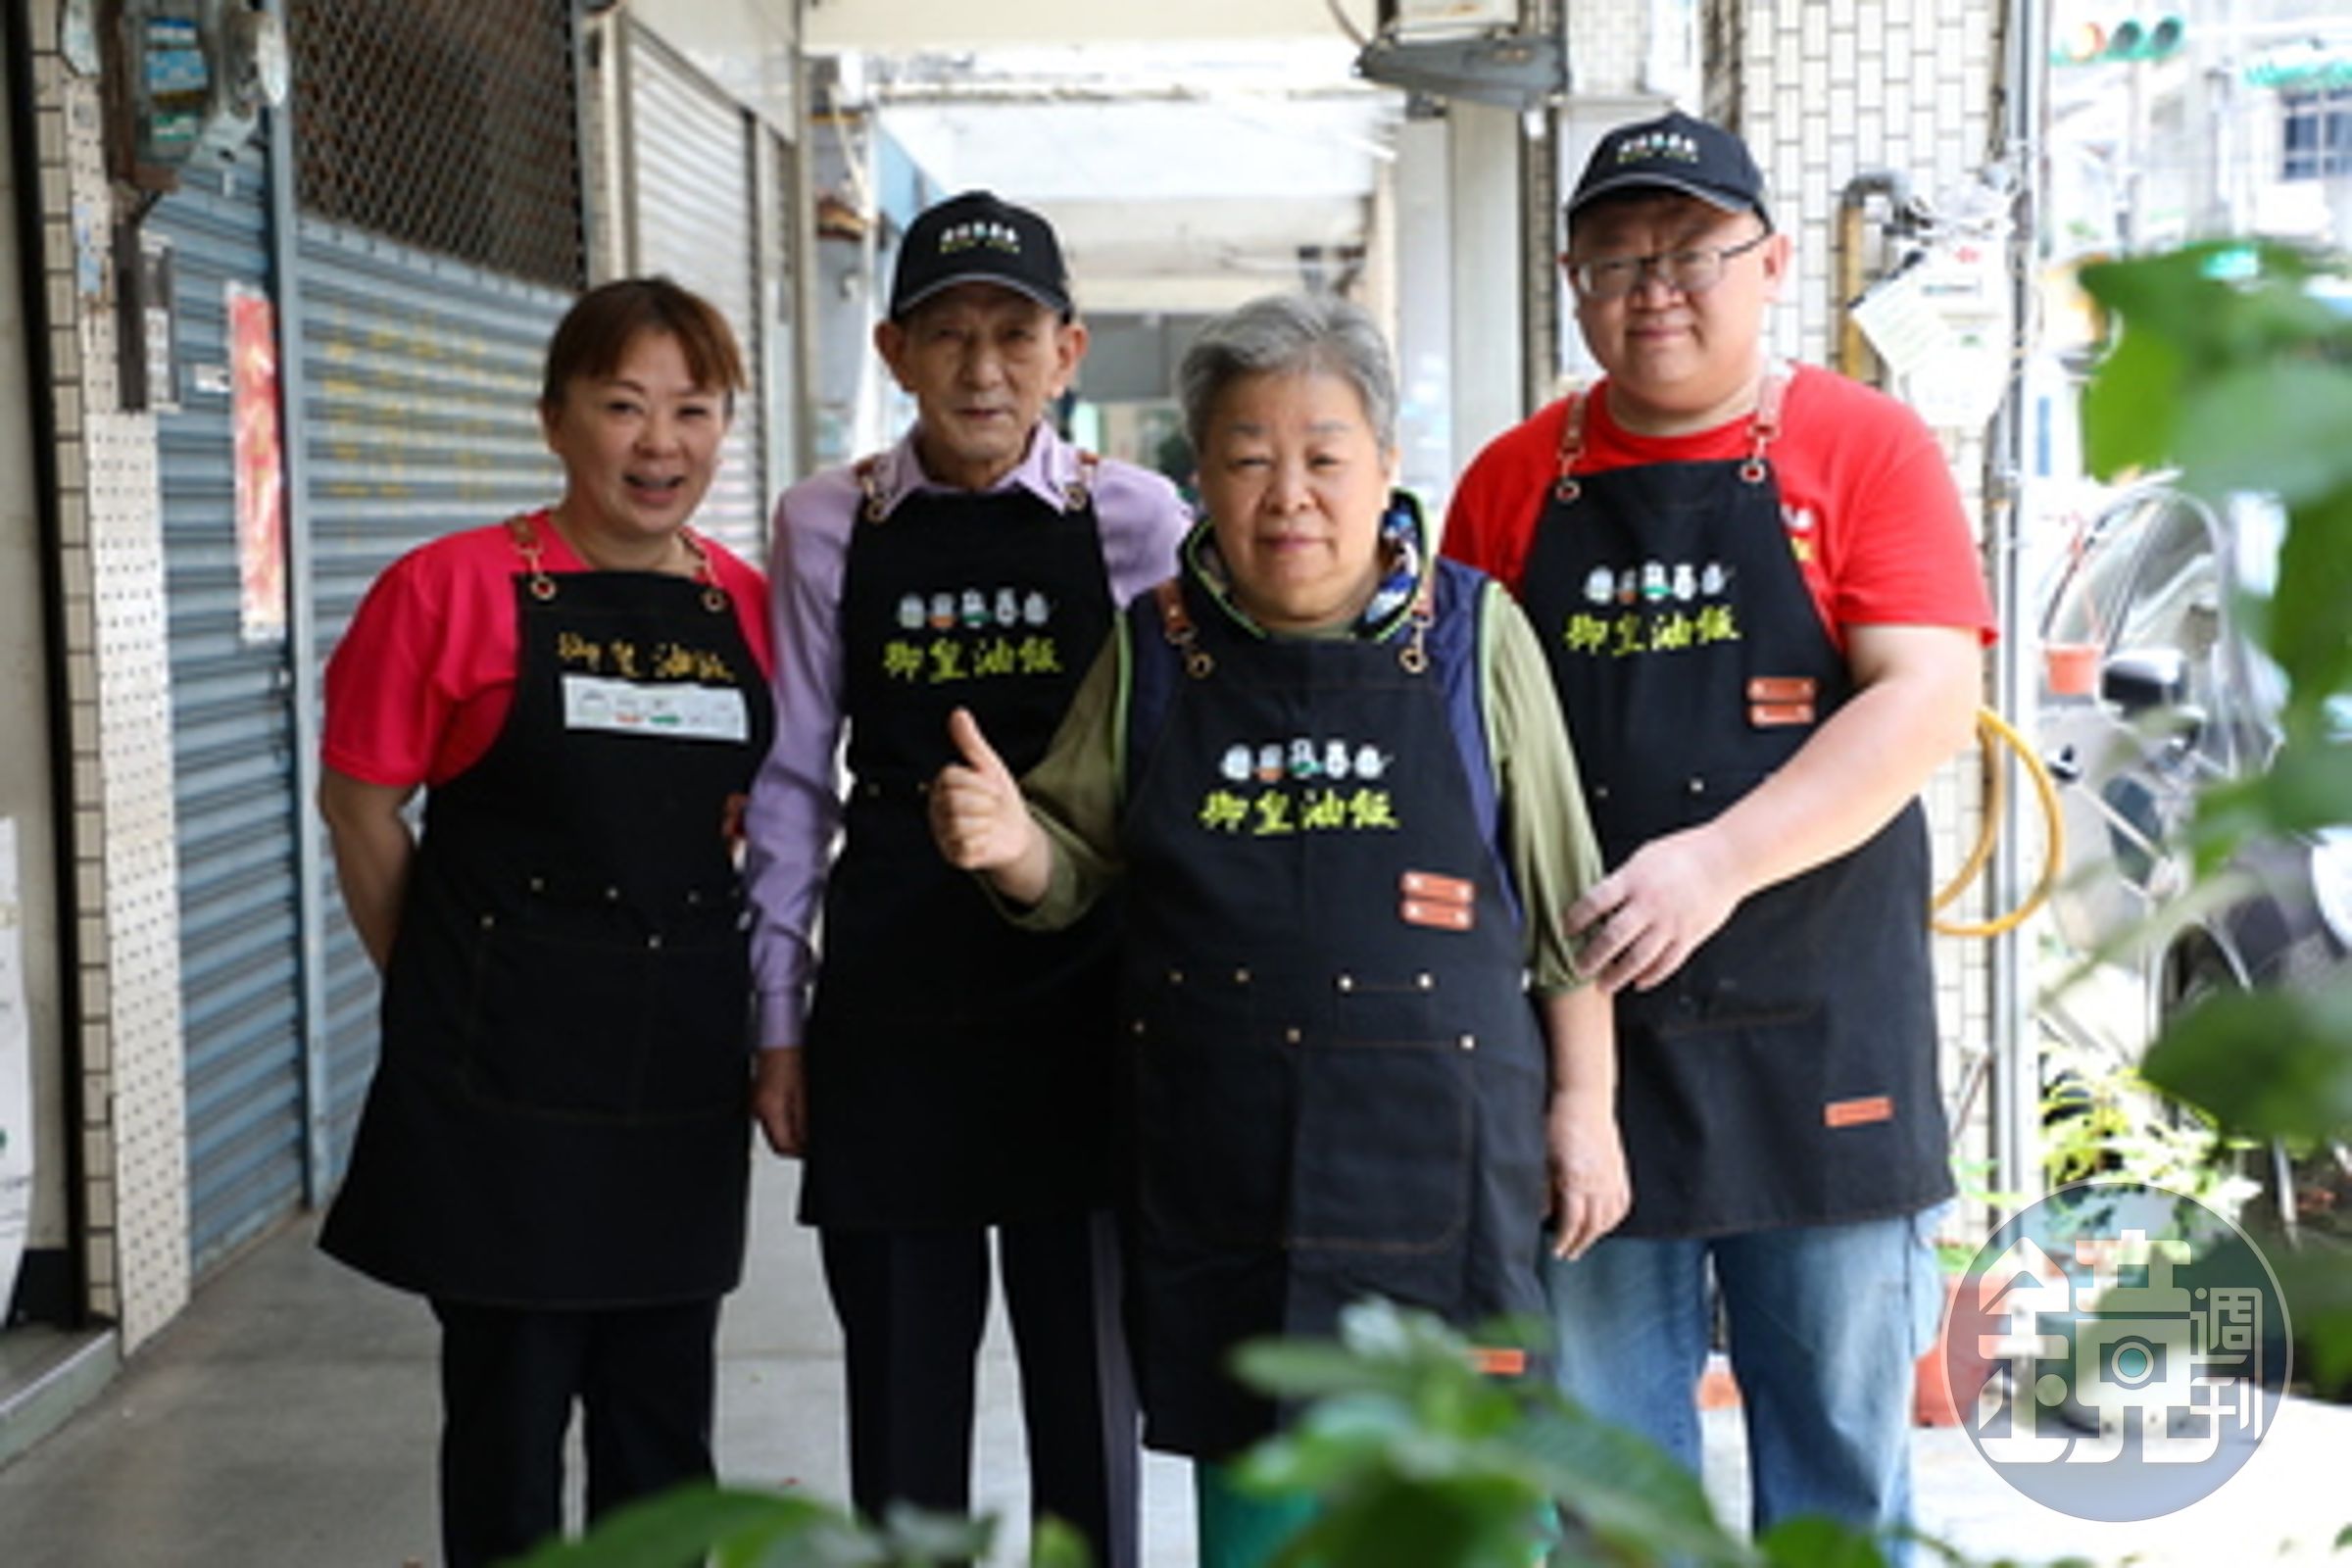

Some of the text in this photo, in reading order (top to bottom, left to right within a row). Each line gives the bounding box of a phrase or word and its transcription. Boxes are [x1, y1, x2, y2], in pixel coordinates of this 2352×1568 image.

[1566, 606, 1740, 657] 御皇油飯
[884, 637, 1064, 681] 御皇油飯
[1199, 789, 1401, 835] 御皇油飯
